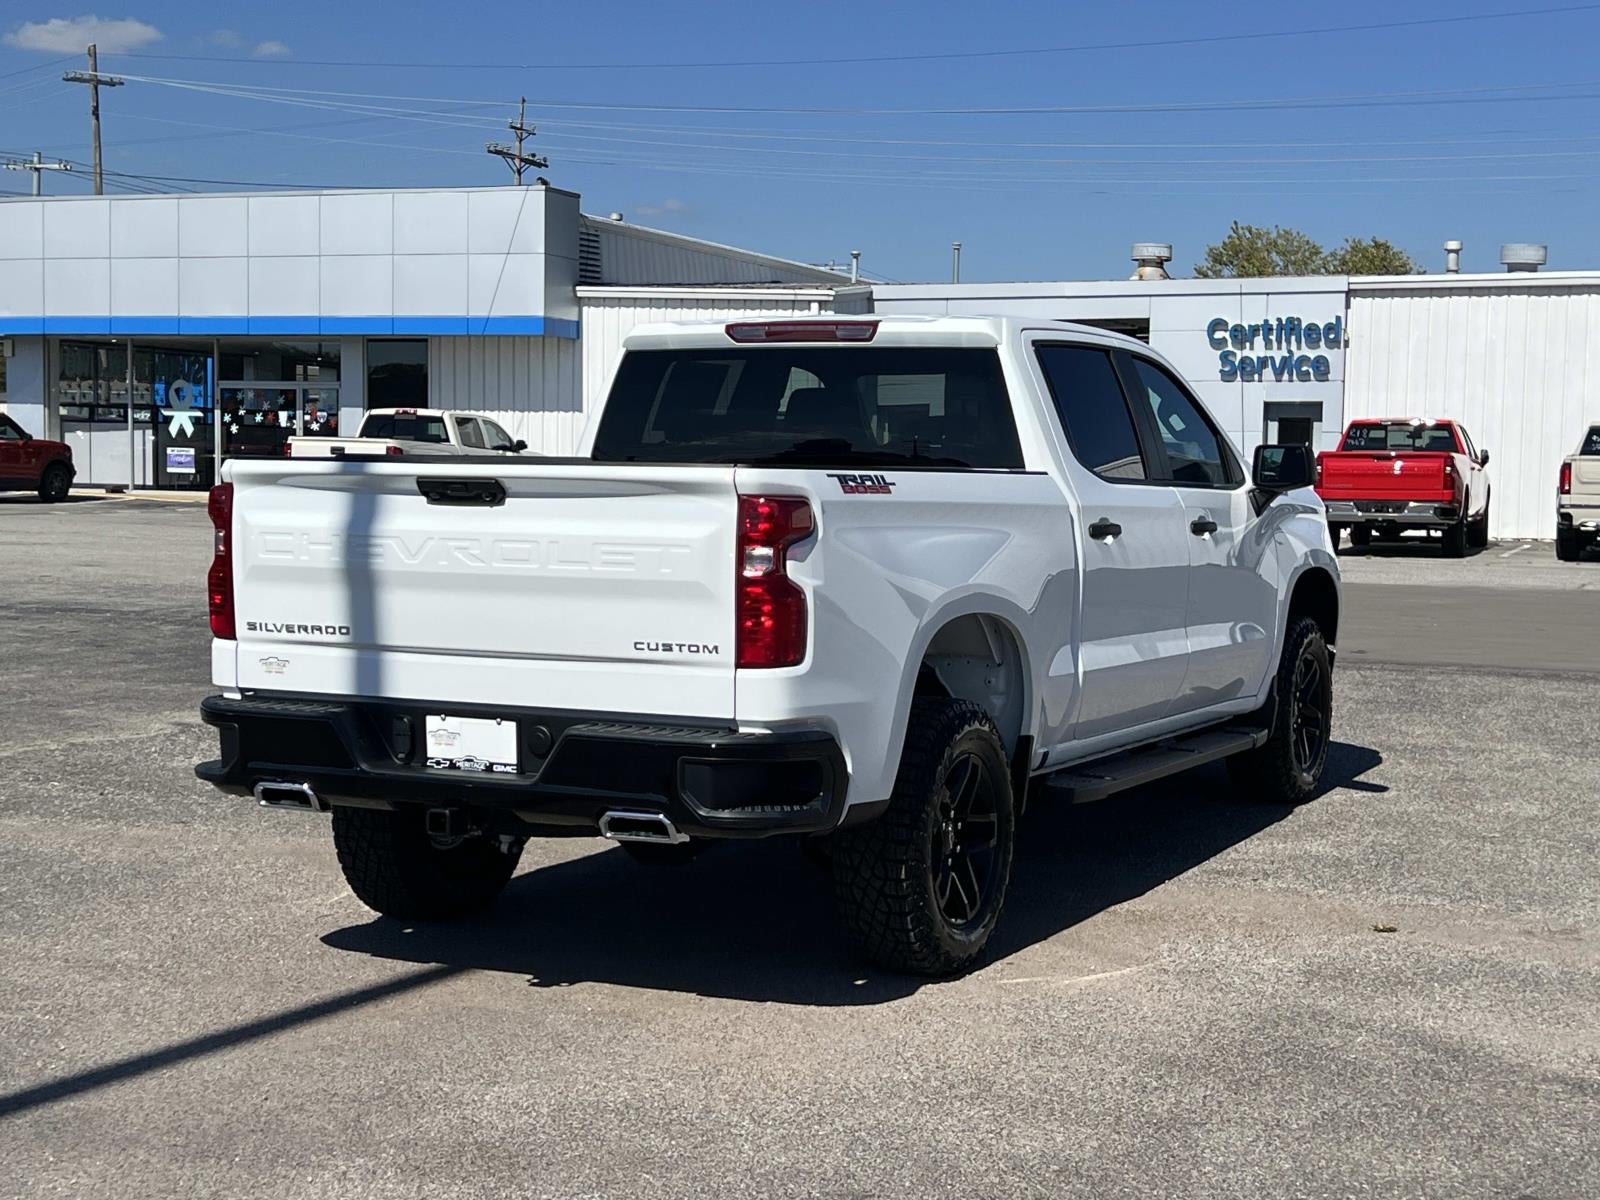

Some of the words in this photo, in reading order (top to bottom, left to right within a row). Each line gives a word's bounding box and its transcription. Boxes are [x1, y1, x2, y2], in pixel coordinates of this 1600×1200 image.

[1207, 315, 1342, 349] Certified
[1219, 350, 1330, 382] Service
[826, 473, 896, 486] TRAIL
[257, 531, 691, 573] CHEVROLET
[246, 621, 351, 636] SILVERADO
[633, 641, 719, 655] CUSTOM
[455, 761, 486, 770] HERITAGE
[492, 764, 517, 773] GMC
